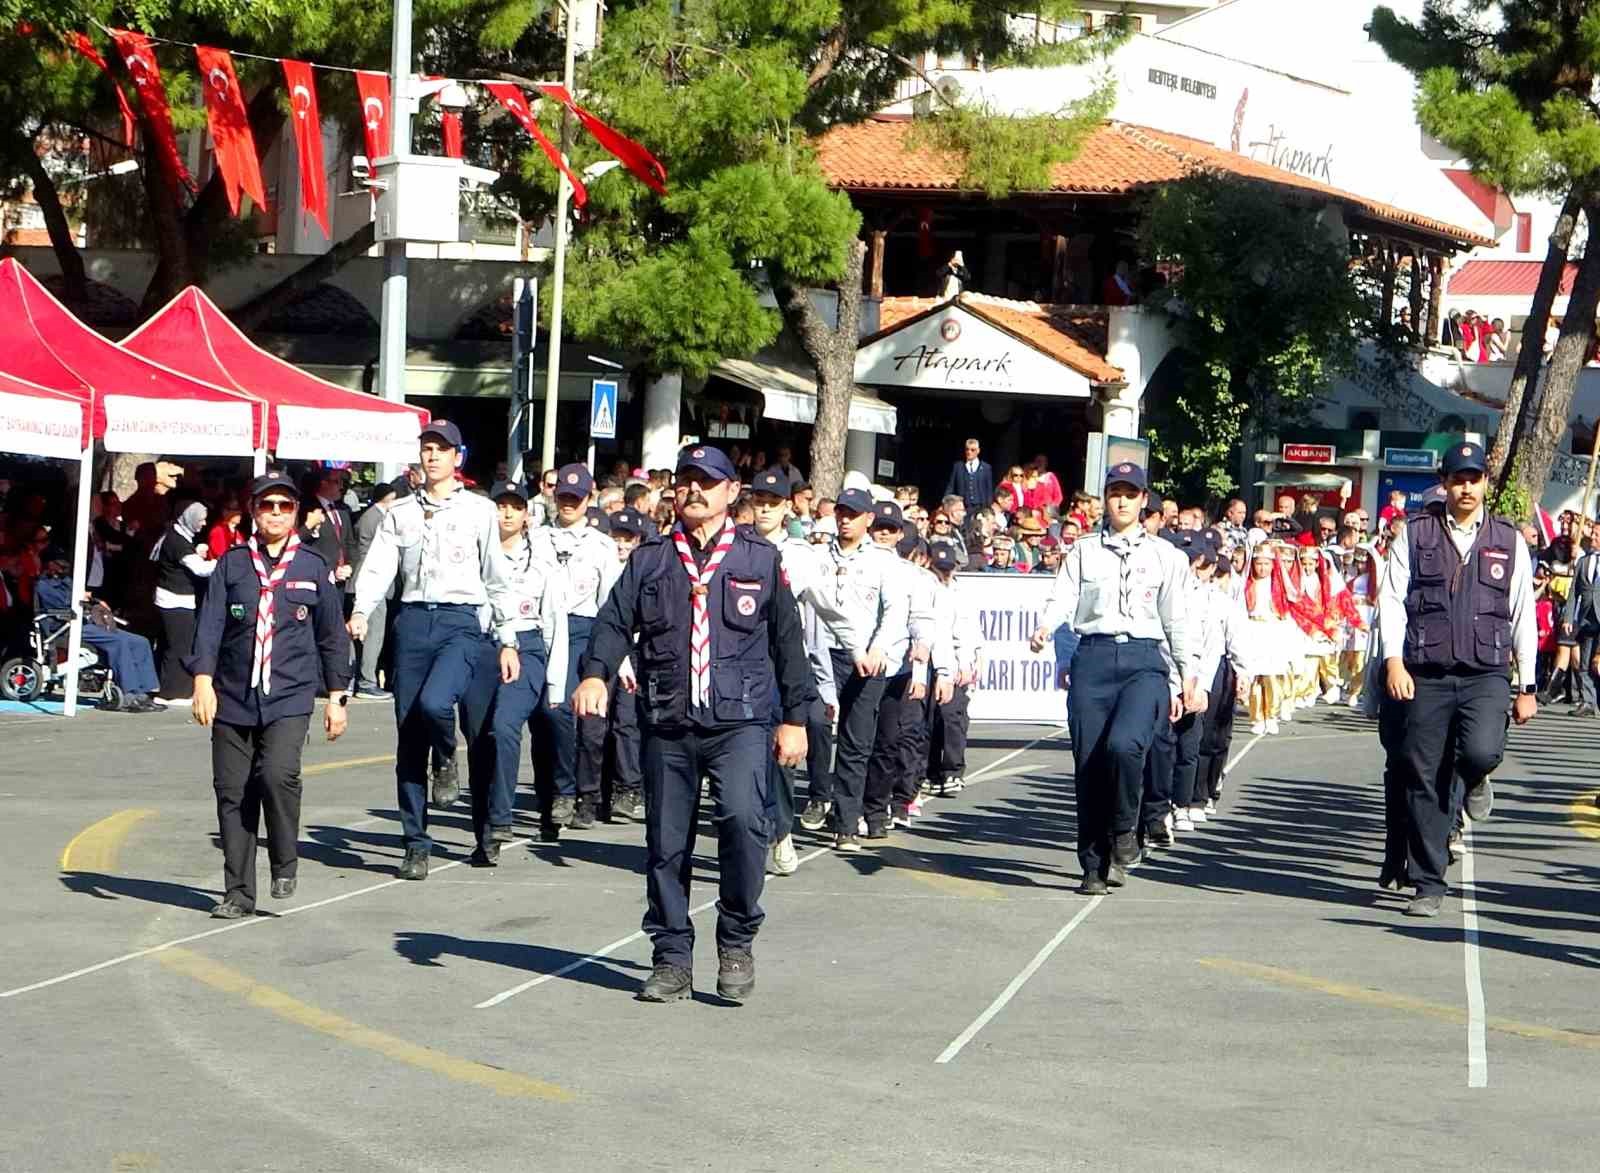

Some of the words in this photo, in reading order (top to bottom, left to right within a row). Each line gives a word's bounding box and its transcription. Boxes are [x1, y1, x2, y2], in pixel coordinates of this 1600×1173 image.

[1248, 124, 1334, 185] Atapark
[893, 344, 1013, 385] Atapark
[1287, 449, 1329, 457] AKBANK
